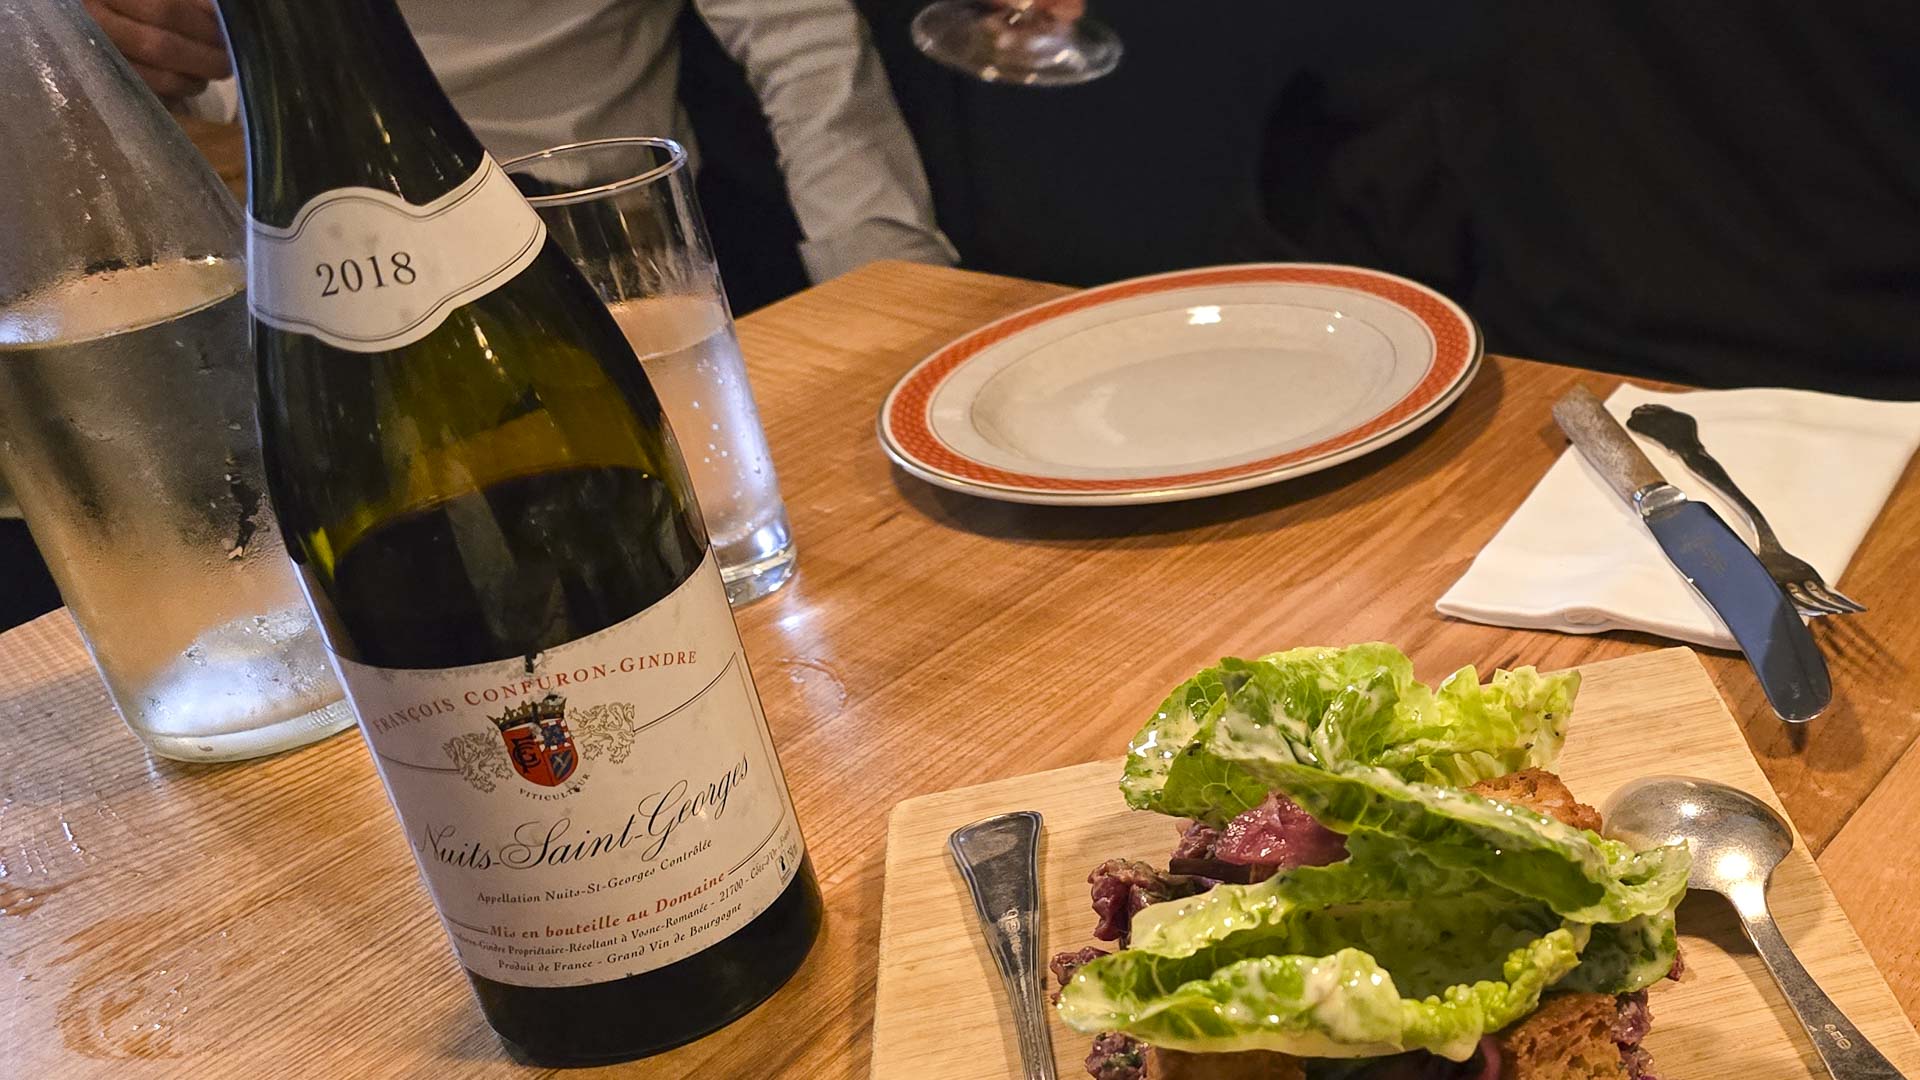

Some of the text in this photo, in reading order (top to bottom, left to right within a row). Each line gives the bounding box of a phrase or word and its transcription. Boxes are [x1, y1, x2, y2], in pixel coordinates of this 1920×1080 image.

[316, 251, 416, 297] 2018
[373, 651, 697, 735] FRANÇOIS CONFURON-GINDRE
[418, 752, 749, 871] Nuits-Saint-Georges
[477, 838, 713, 905] Appellation Nuits-St-Georges Contrôlée
[490, 871, 725, 939] Mis en bouteille au Domaine
[498, 959, 534, 972] Produit
[538, 961, 549, 972] de
[554, 960, 593, 972] France
[607, 946, 645, 965] Grand
[649, 940, 670, 952] Vin
[674, 933, 686, 944] de
[690, 902, 742, 937] Bourgogne
[631, 902, 709, 940] Vosne-Romanée
[719, 877, 744, 903] 21700
